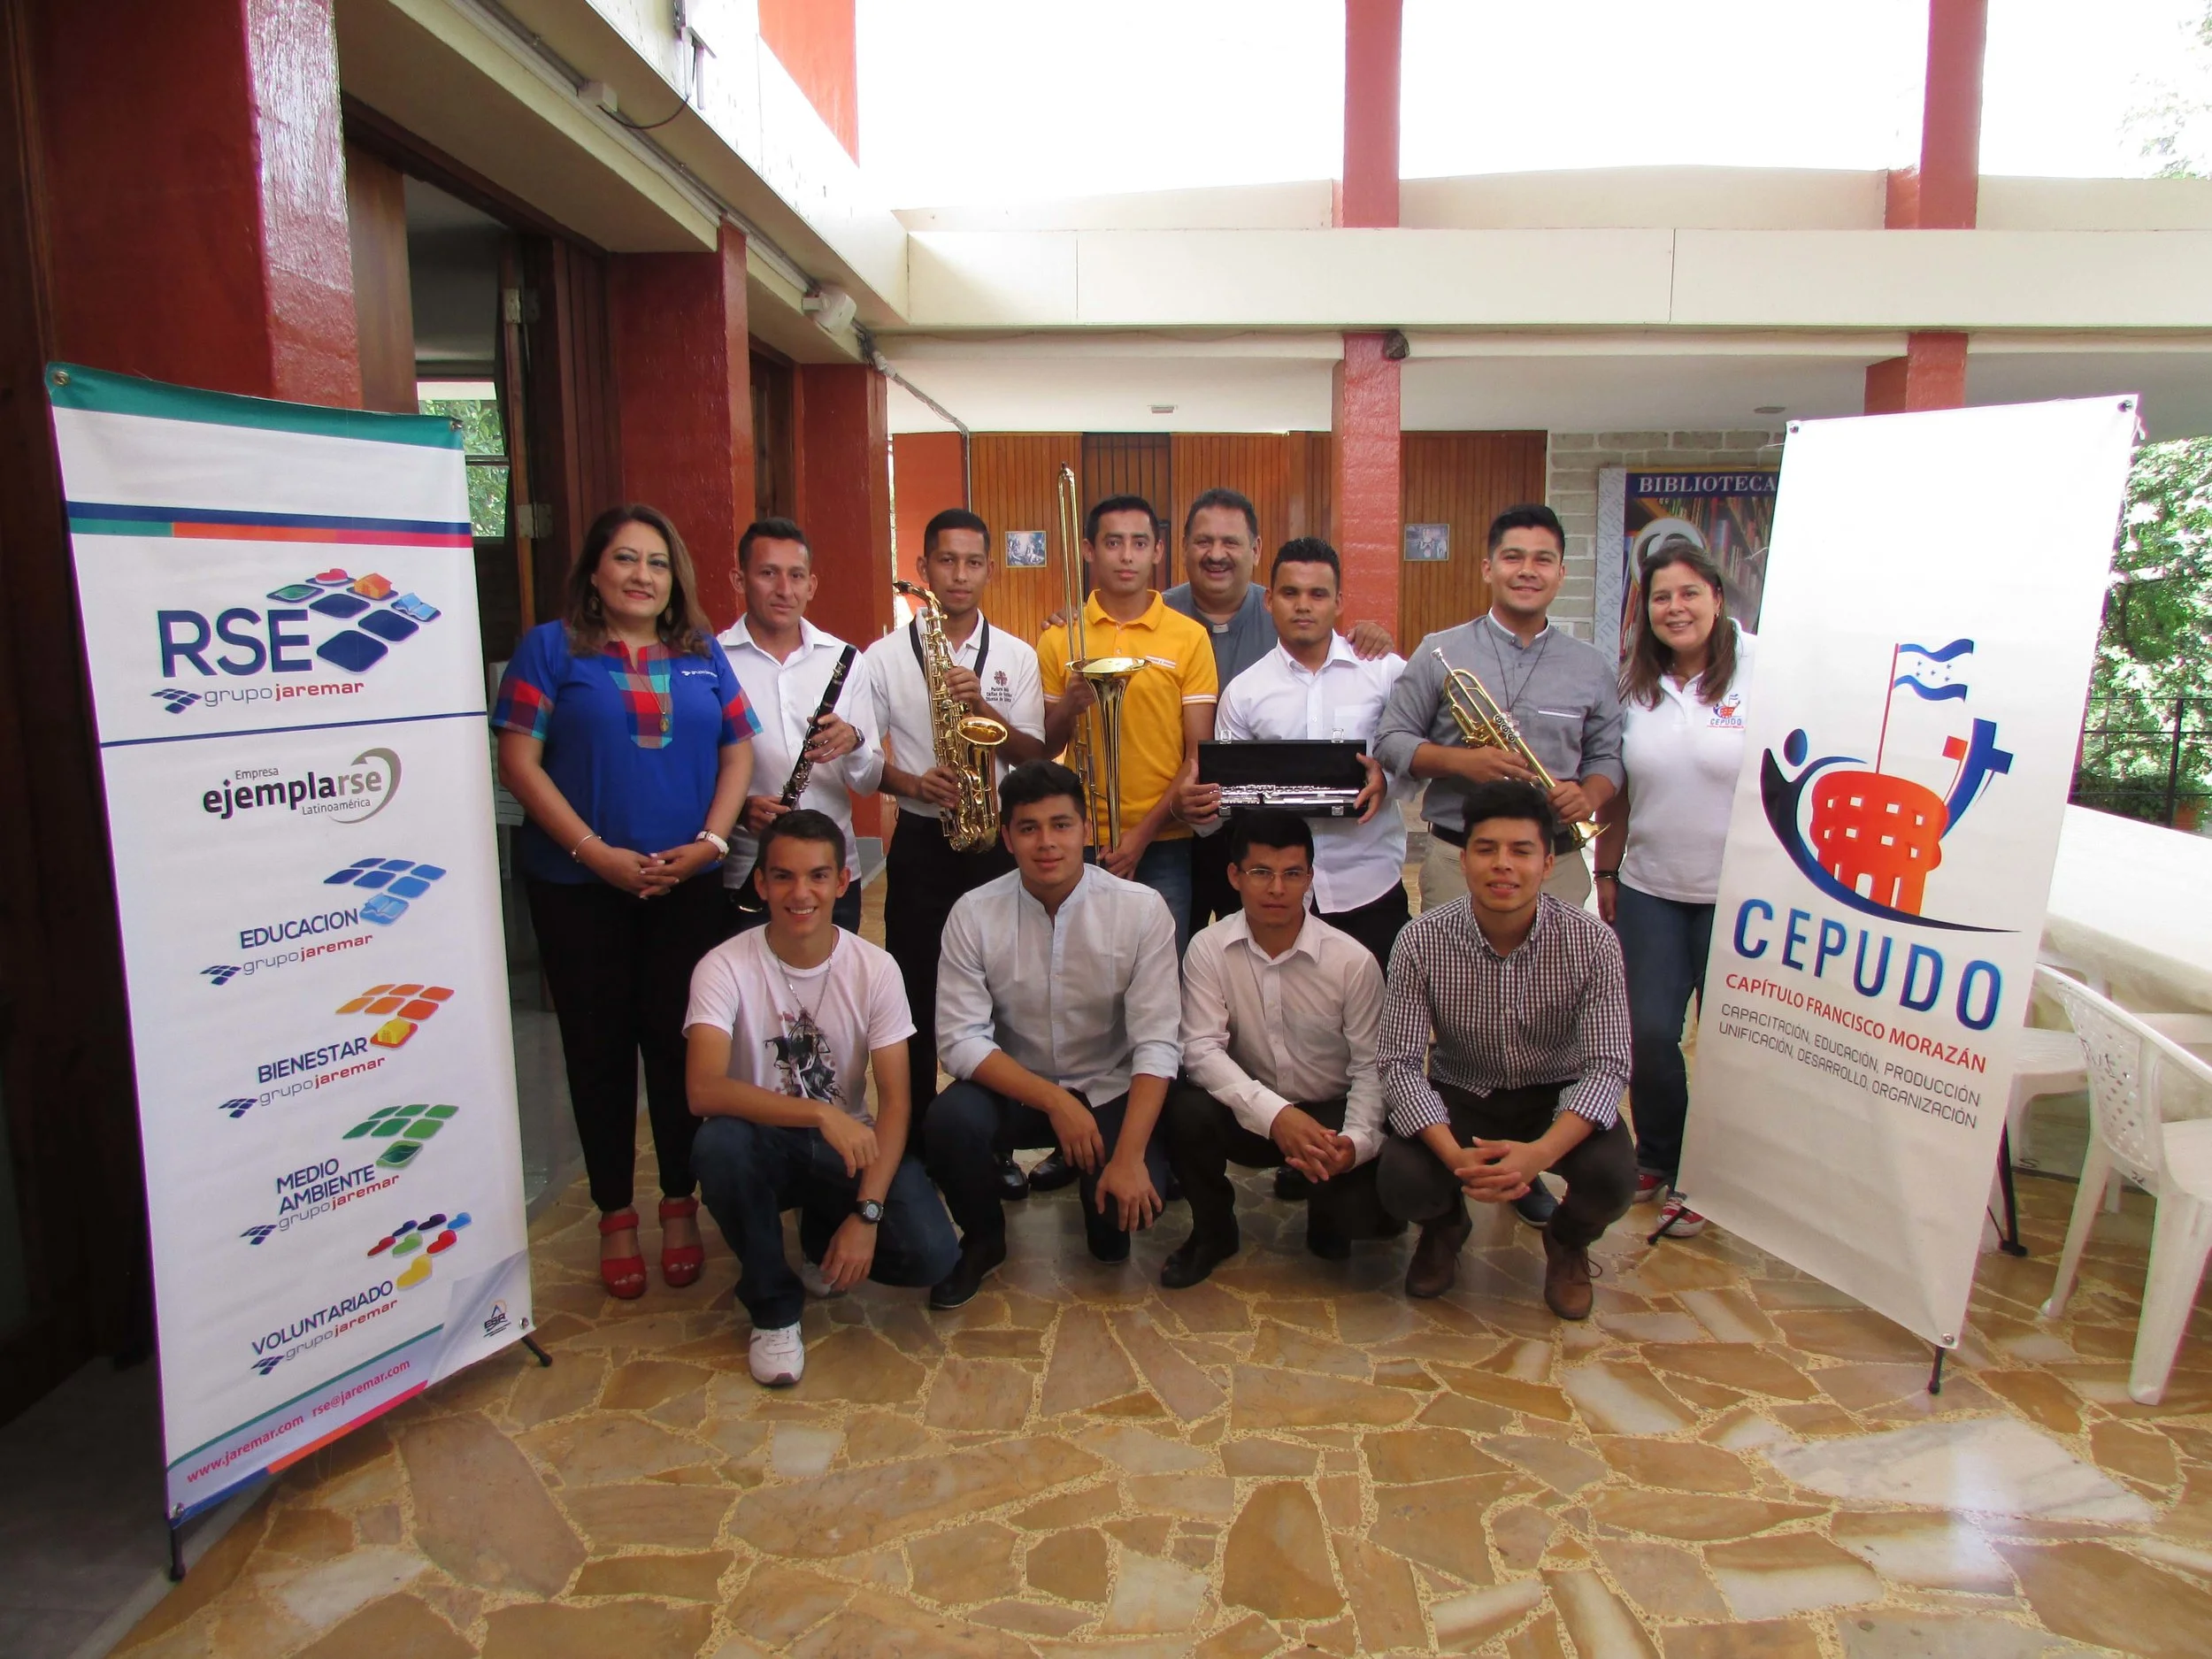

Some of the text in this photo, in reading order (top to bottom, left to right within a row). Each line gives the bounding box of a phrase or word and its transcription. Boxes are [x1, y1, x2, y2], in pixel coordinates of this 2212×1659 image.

[1639, 476, 1776, 492] BIBLIOTECA
[157, 608, 313, 677] RSE
[203, 769, 382, 819] ejemplarse
[234, 766, 279, 780] Empresa
[302, 798, 371, 816] Latinoamérica
[240, 909, 358, 949] EDUCACION
[1733, 899, 2002, 1032] CEPUDO
[1726, 974, 1986, 1073] CAPÍTULO FRANCISCO MORAZÁN
[257, 1037, 367, 1084] BIENESTAR
[1884, 1063, 1980, 1107] PRODUCCIÓN
[1872, 1080, 1977, 1129] ORGANIZACIÓN
[277, 1158, 340, 1194] MEDIO
[279, 1164, 375, 1215] AMBIENTE
[251, 1280, 393, 1356] VOLUNTARIADO
[187, 1360, 410, 1483] www.jaremar.com rse@jaremar.com
